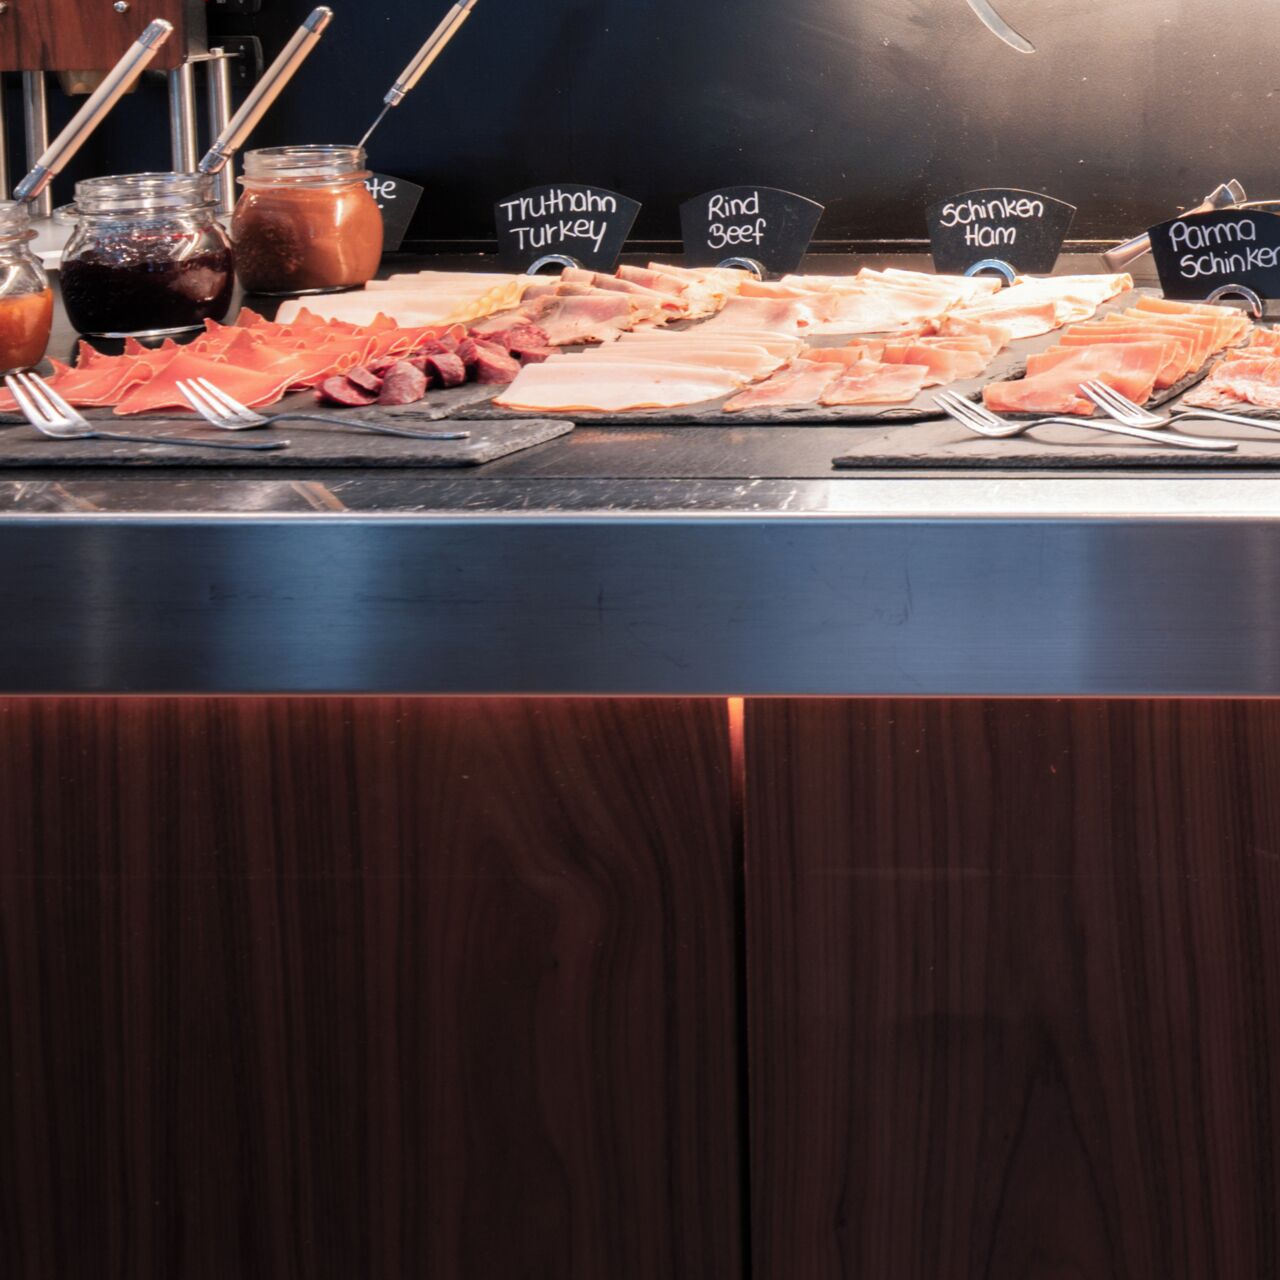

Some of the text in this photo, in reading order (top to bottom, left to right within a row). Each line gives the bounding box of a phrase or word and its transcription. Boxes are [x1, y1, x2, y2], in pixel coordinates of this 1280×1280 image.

[499, 188, 618, 222] Truthahn
[707, 191, 760, 221] Rind
[509, 218, 608, 253] Turkey
[707, 218, 767, 249] Beef
[964, 223, 1017, 248] Ham
[1169, 219, 1256, 252] Parma
